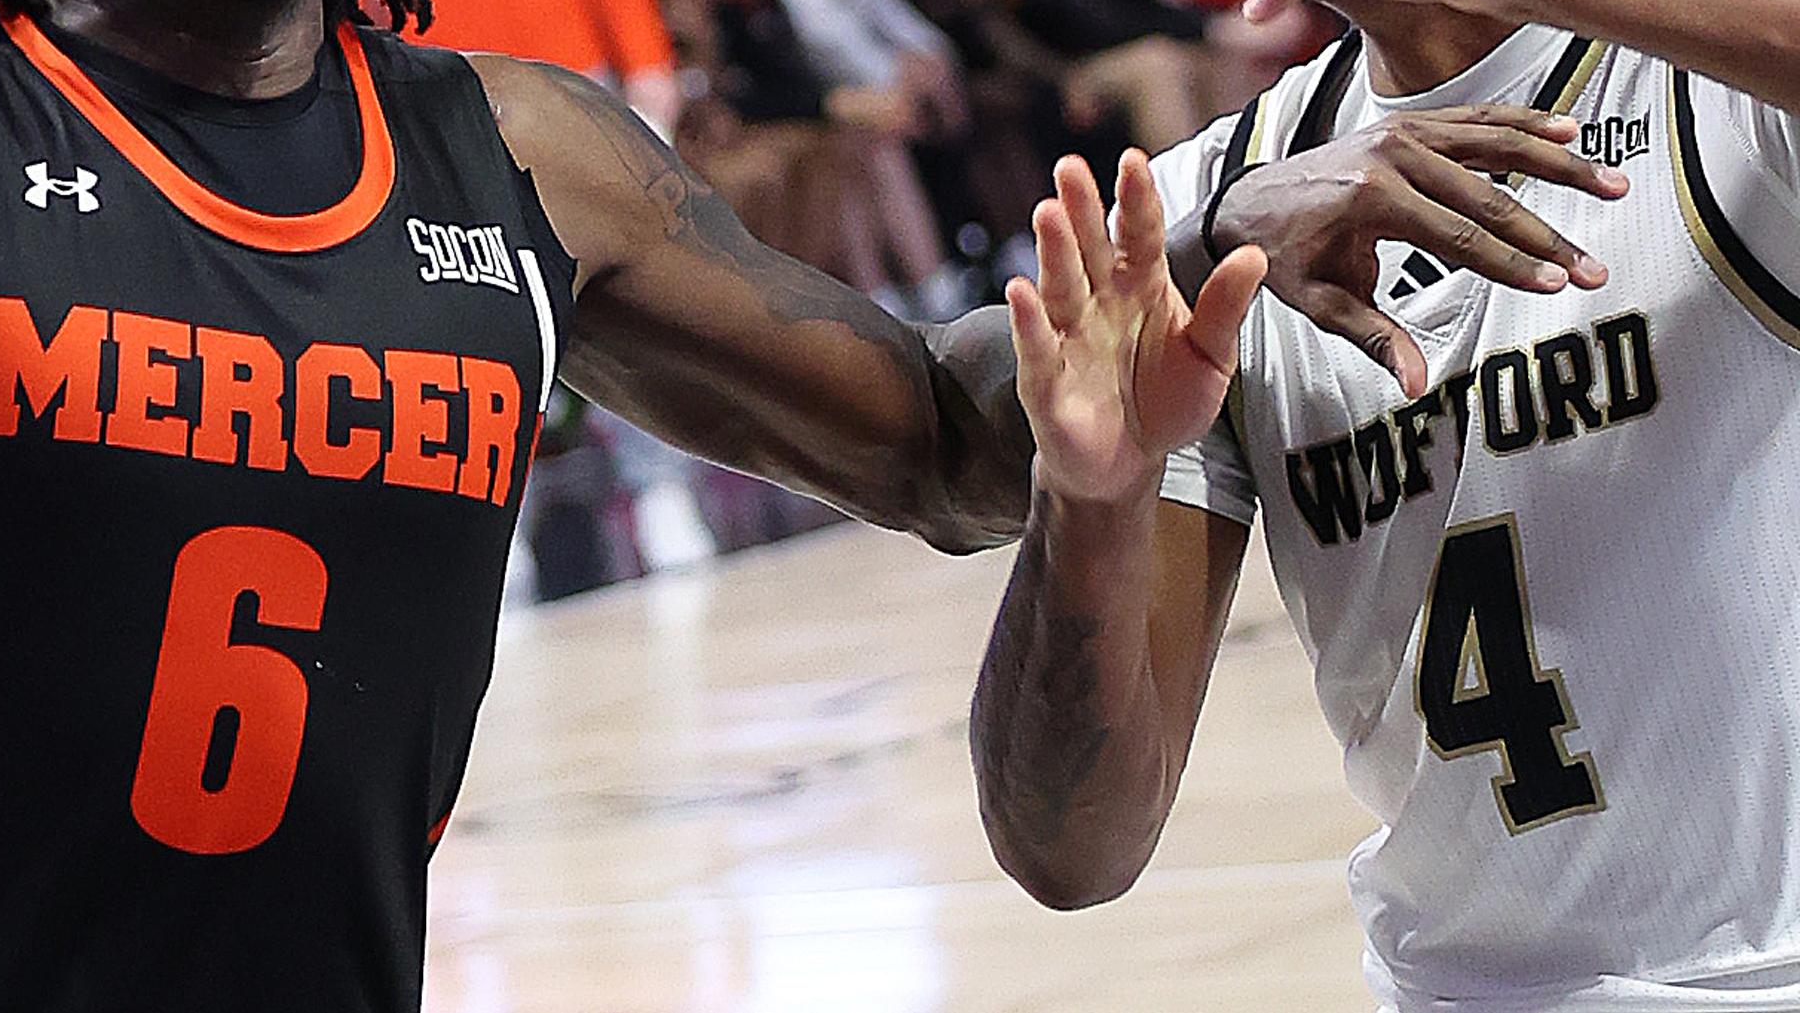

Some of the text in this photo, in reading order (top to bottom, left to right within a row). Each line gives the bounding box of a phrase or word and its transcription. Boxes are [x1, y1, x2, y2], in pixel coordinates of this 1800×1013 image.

[1580, 104, 1651, 168] OCON
[406, 217, 520, 295] SOCON
[130, 525, 329, 855] 6
[1414, 511, 1607, 836] 4
